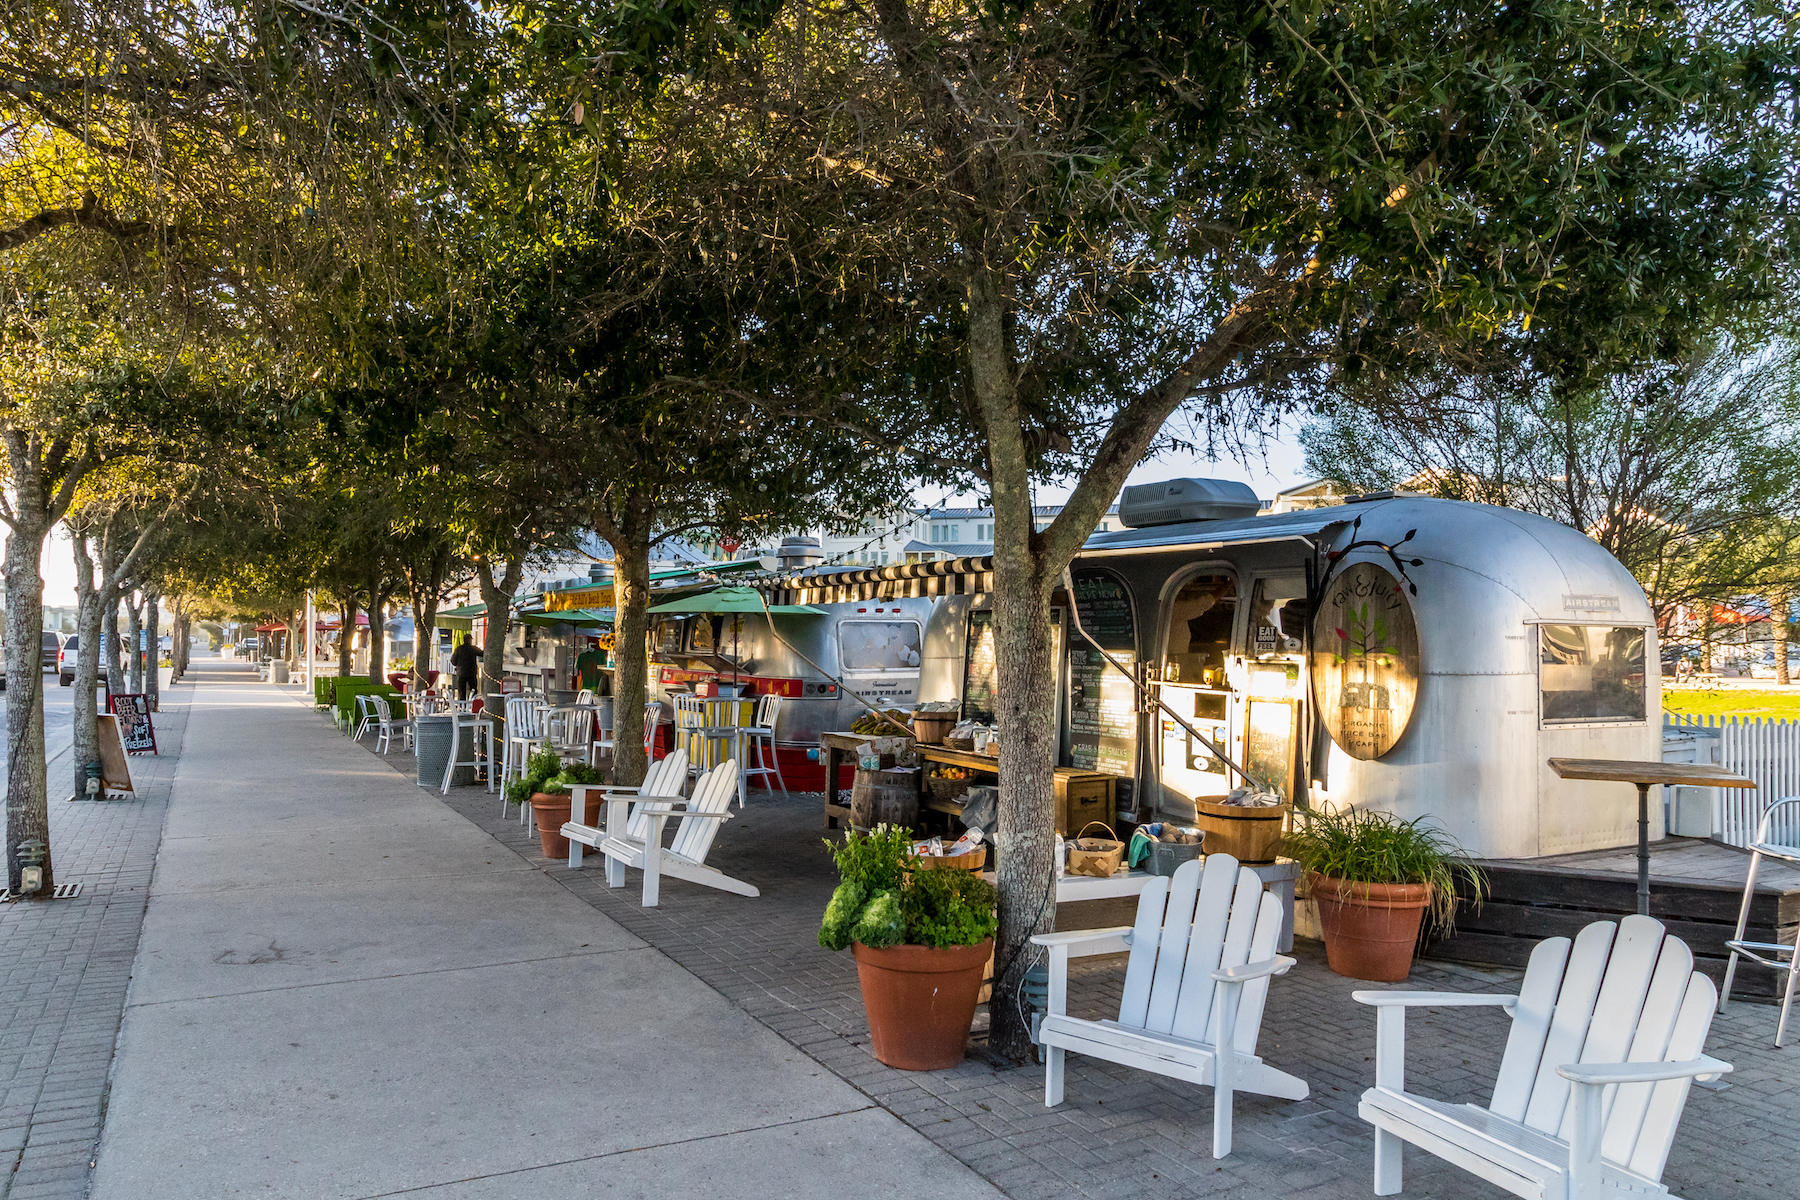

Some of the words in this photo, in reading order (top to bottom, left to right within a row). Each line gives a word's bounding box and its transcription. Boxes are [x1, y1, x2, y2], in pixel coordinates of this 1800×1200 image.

[1078, 577, 1104, 591] EAT
[1355, 574, 1370, 597] &
[1259, 626, 1275, 636] EAT
[114, 696, 133, 707] ROOT
[117, 704, 137, 717] BEER
[1343, 720, 1385, 729] ORGANIC
